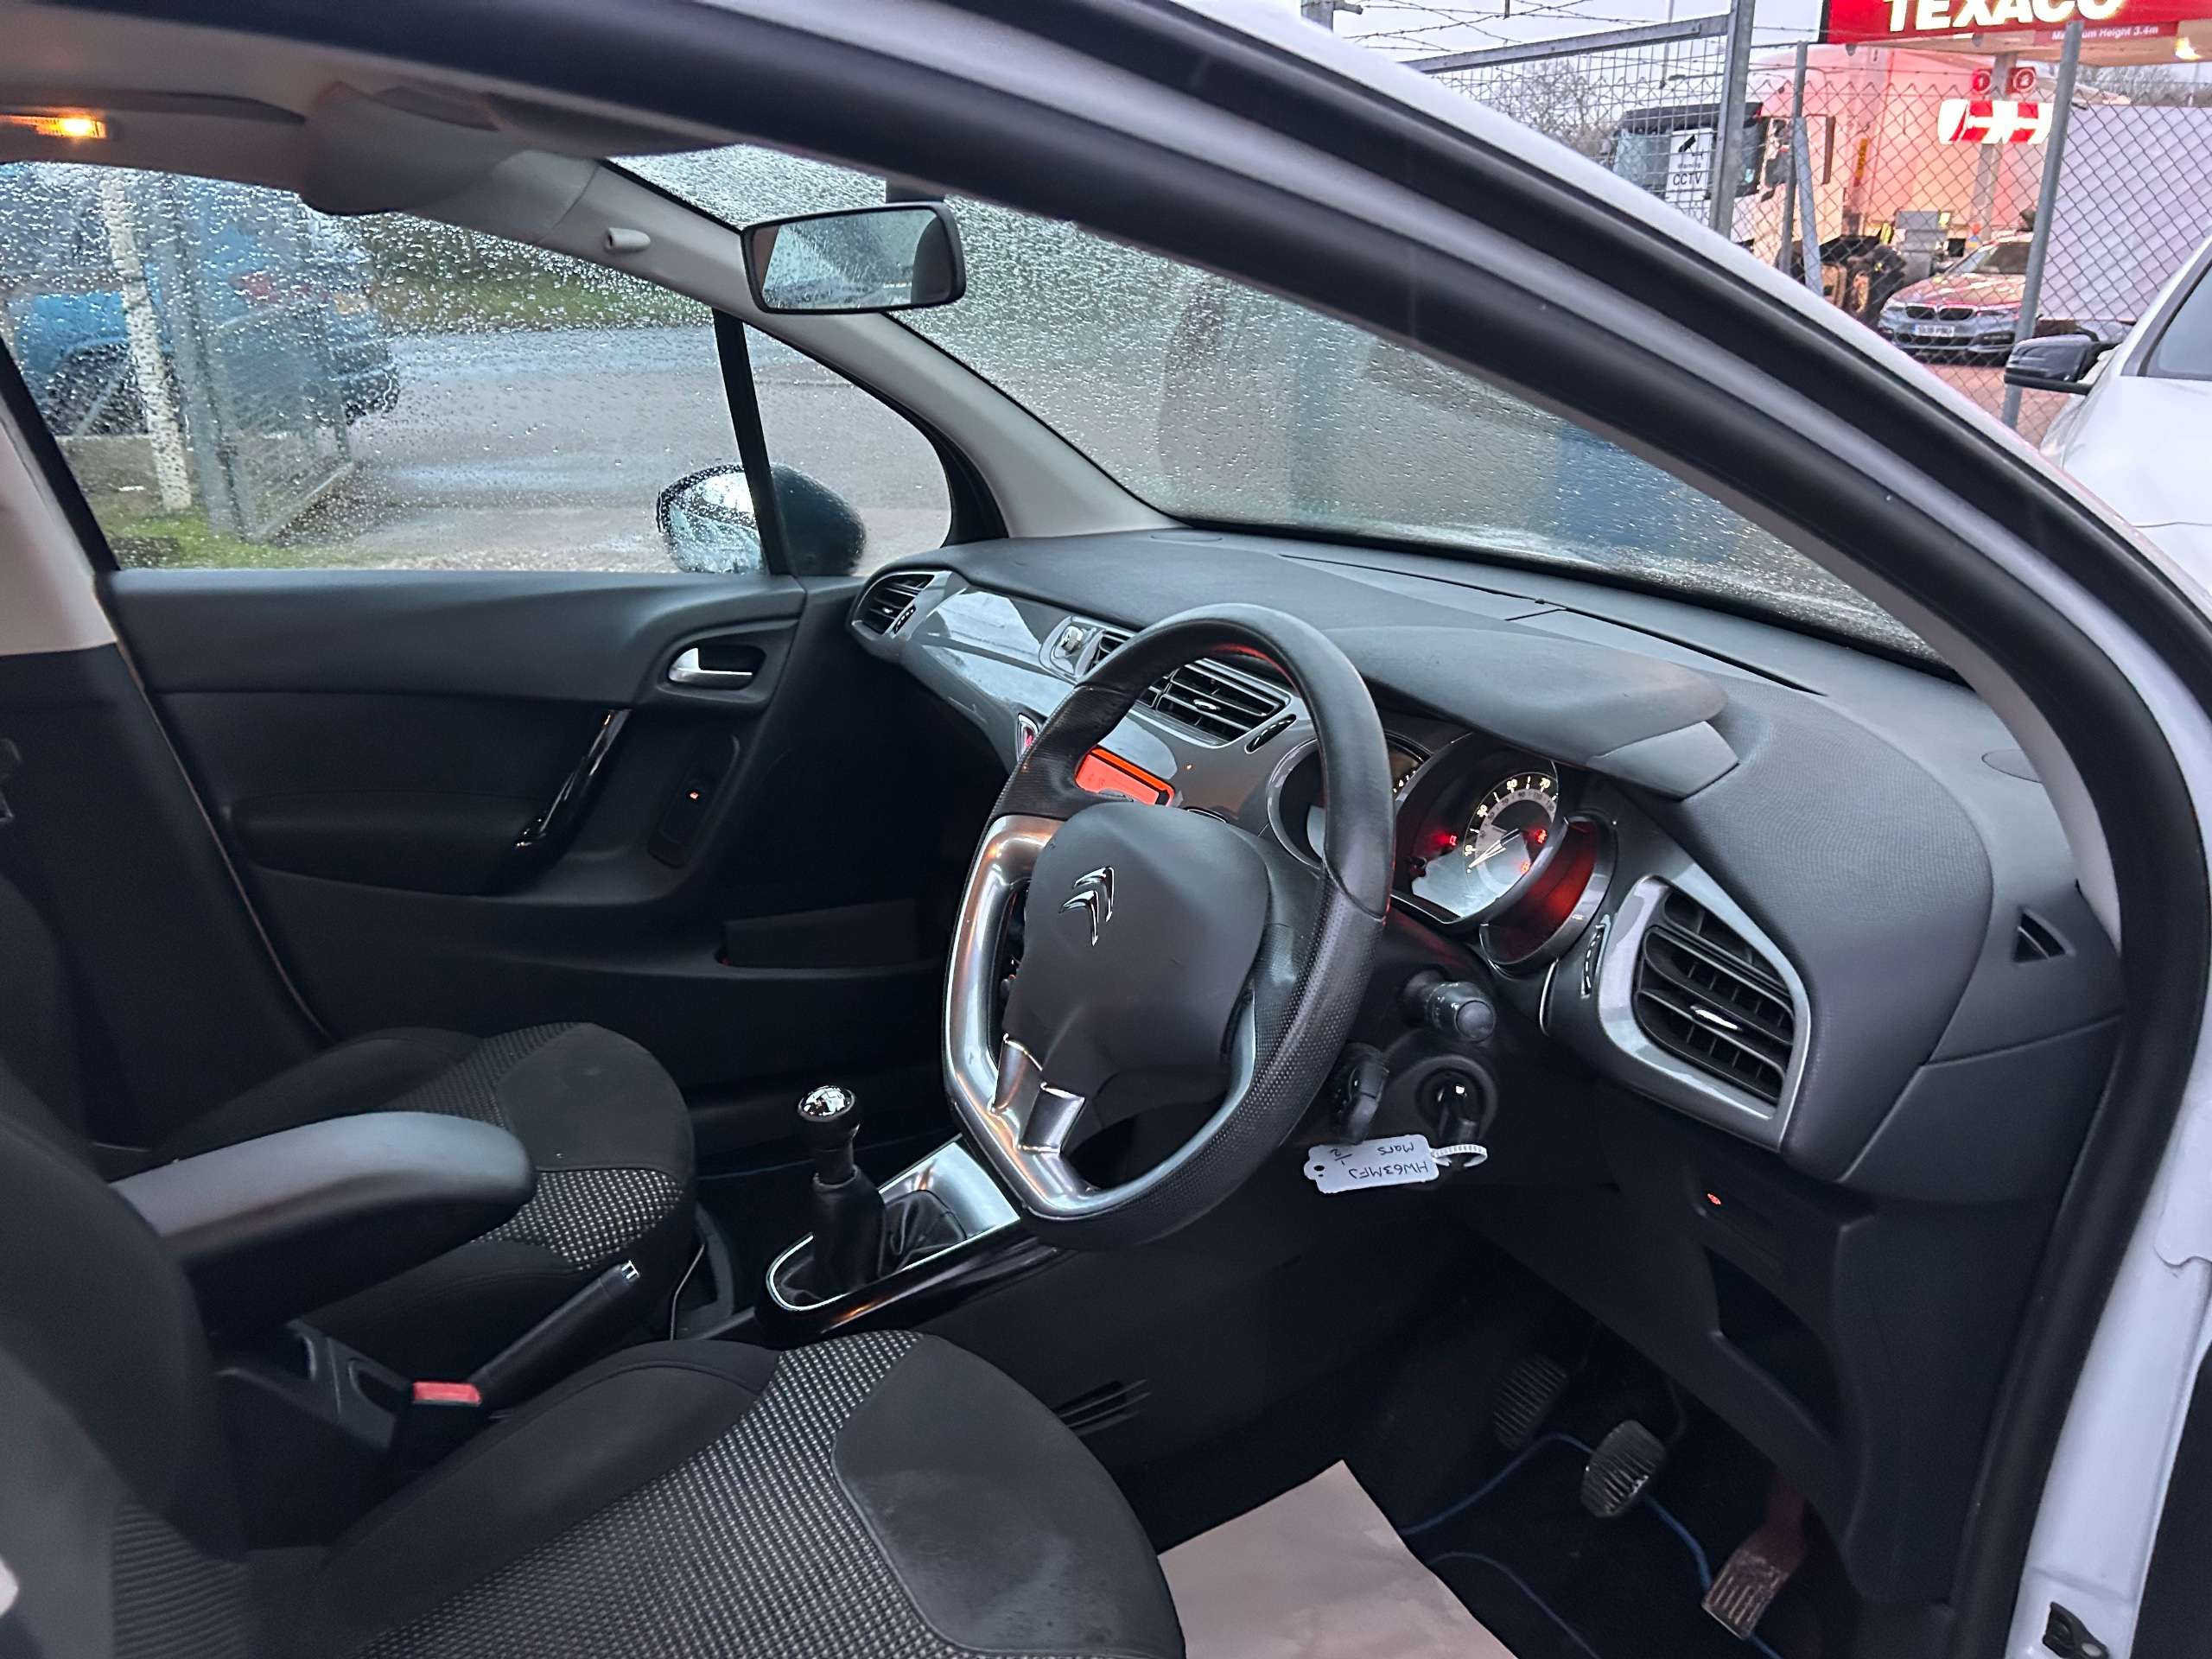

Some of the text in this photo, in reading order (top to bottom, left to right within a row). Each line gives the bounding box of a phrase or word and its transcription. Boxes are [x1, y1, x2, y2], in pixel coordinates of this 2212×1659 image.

[2099, 27, 2132, 39] Height
[2133, 25, 2159, 35] 3.4m
[1673, 172, 1703, 186] CCTV
